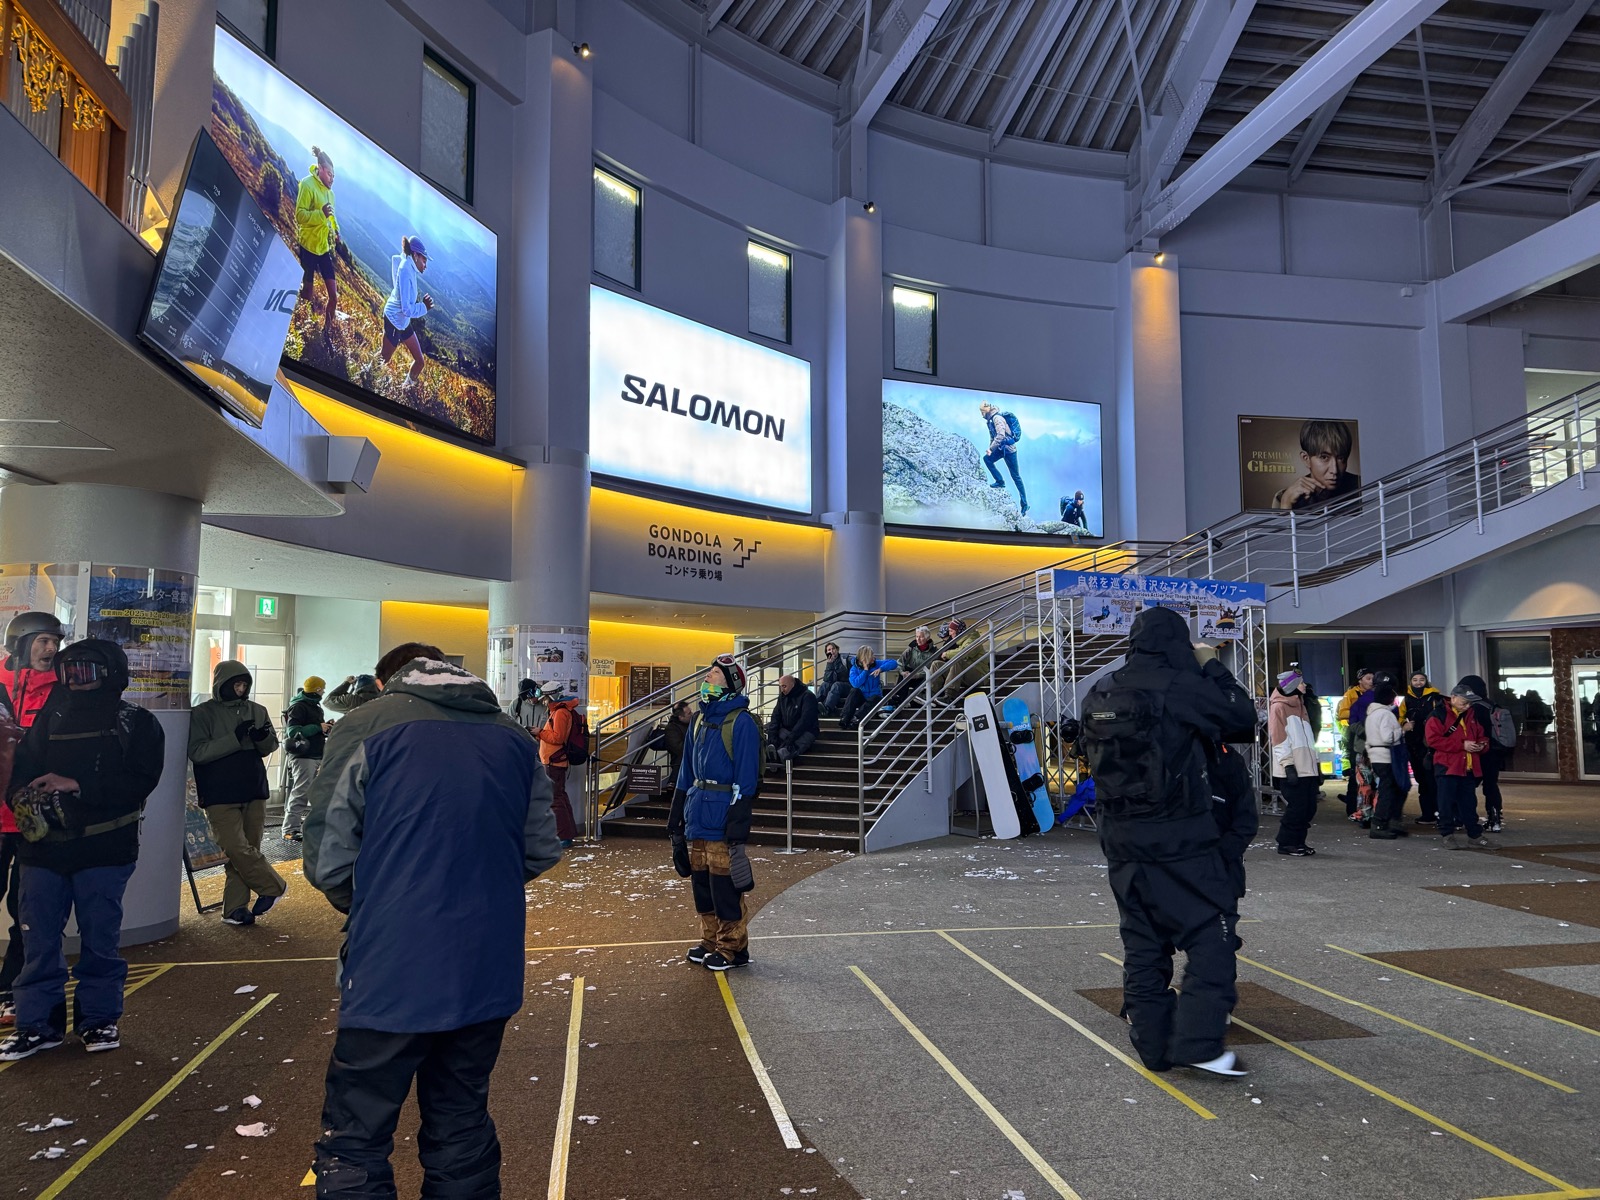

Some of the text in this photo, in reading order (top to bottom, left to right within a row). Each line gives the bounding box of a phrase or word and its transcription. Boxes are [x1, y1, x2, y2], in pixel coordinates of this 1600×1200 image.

[621, 373, 785, 442] SALOMON
[1252, 450, 1293, 460] PREMIUM
[1247, 460, 1296, 474] Ghana
[649, 524, 722, 549] GONDOLA
[648, 543, 722, 566] BOARDING
[664, 564, 723, 582] ゴンドラ乗り場
[1077, 574, 1247, 597] 自然を巡る、贅沢なアクティブツアー
